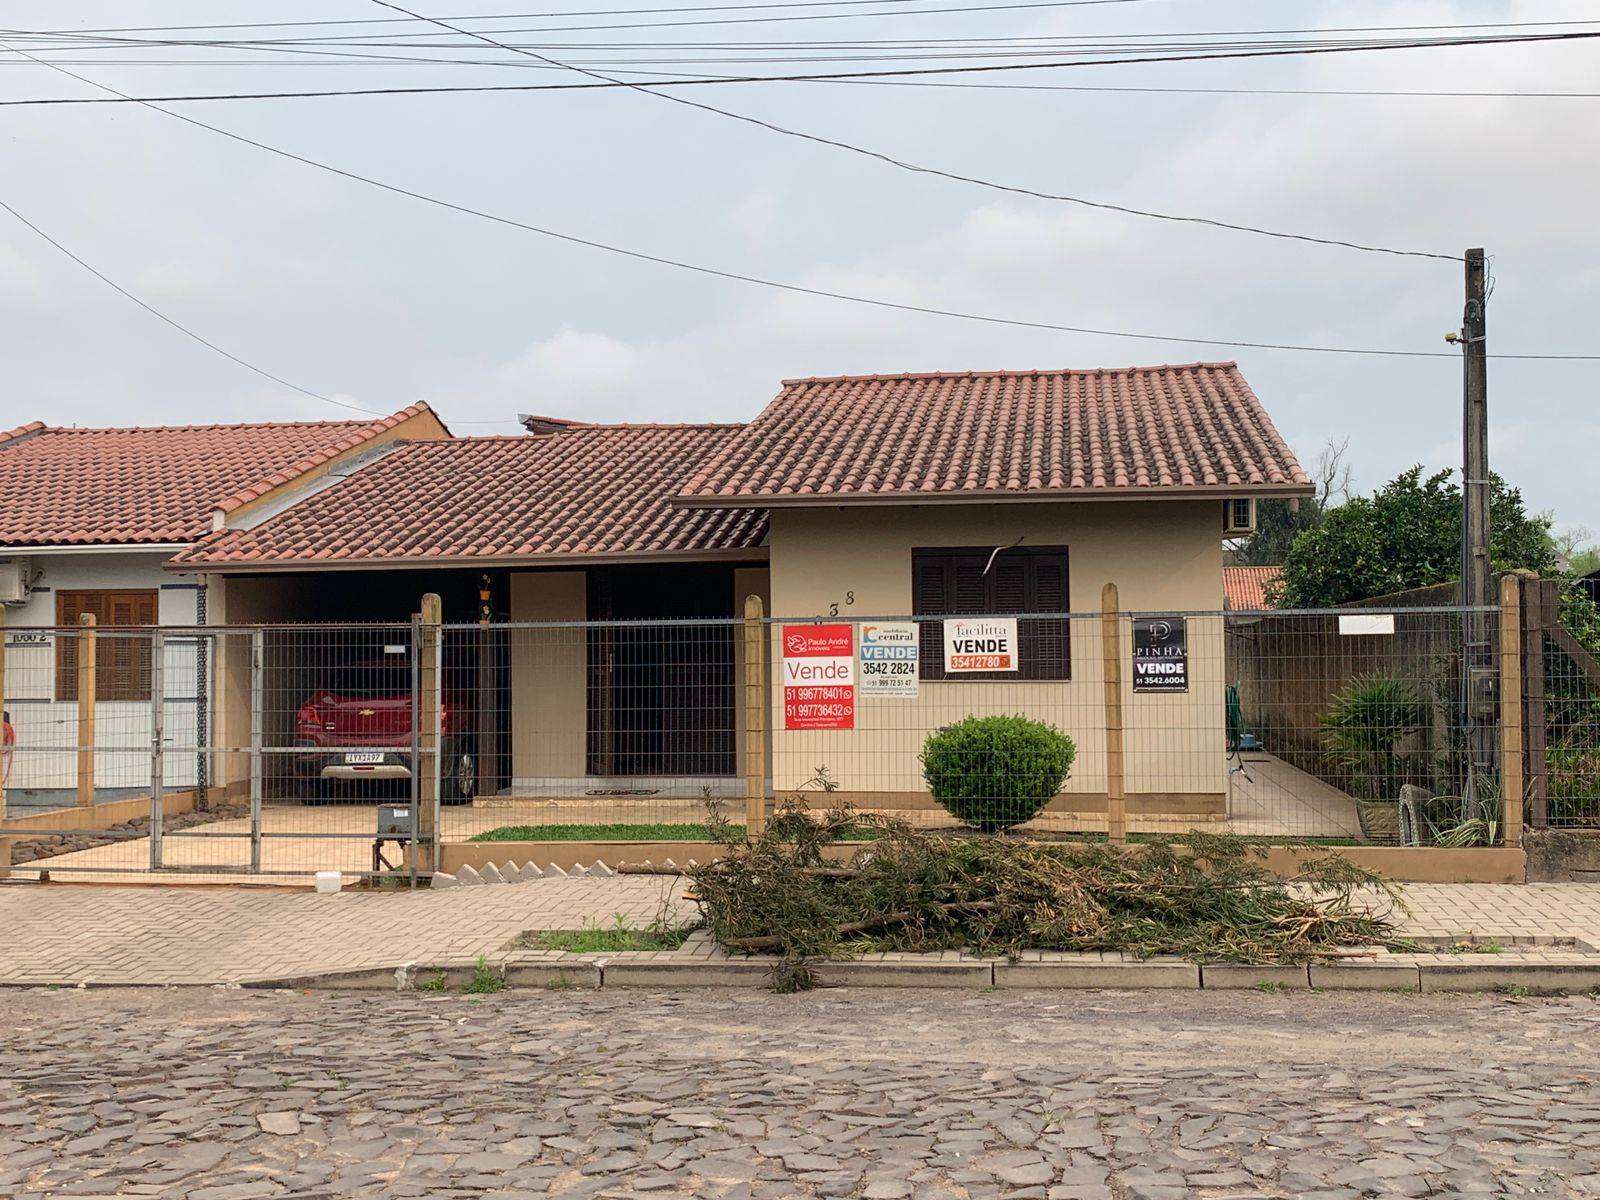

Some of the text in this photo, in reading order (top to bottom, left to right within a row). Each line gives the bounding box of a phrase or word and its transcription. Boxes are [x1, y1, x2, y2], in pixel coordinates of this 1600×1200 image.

[808, 637, 849, 646] Paulo André
[878, 632, 913, 641] central
[953, 640, 1008, 653] VENDE
[1137, 648, 1183, 656] PINHA
[862, 647, 917, 659] VENDE
[952, 656, 1000, 668] 35412780
[788, 660, 849, 679] Vende
[863, 662, 915, 675] 3542 2824
[1136, 663, 1185, 674] VENDE
[1144, 676, 1185, 684] 3542.6004
[786, 688, 796, 700] 51
[786, 704, 796, 717] 51
